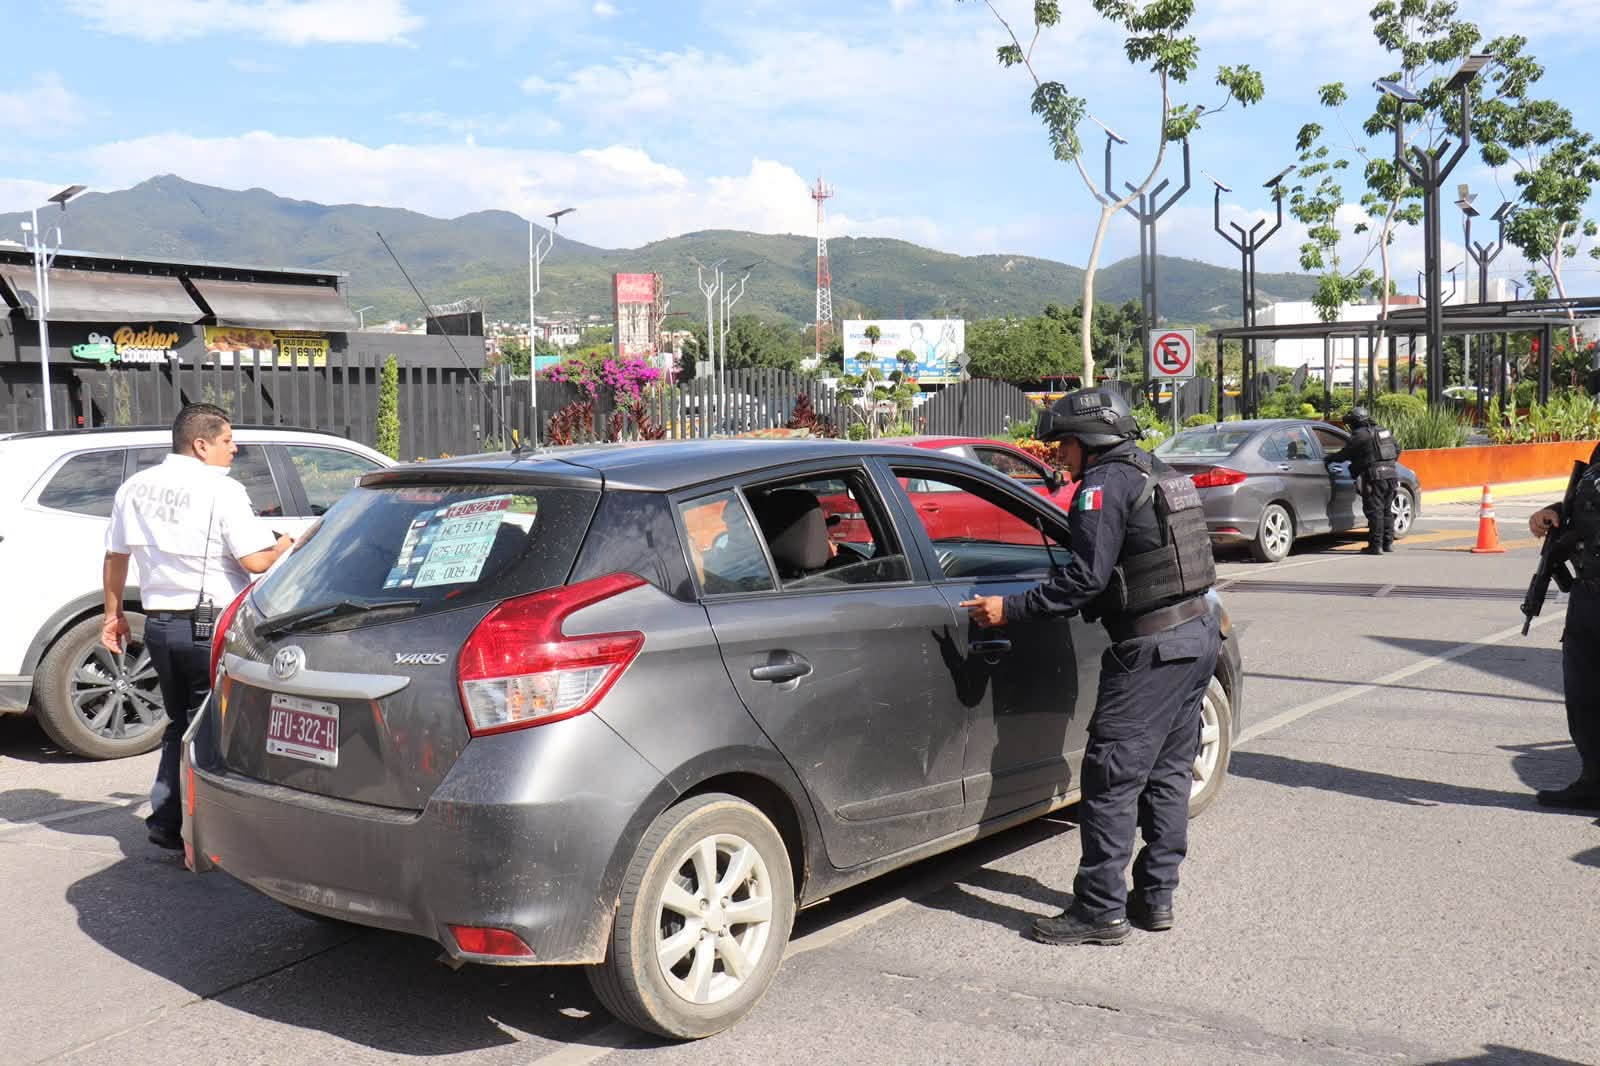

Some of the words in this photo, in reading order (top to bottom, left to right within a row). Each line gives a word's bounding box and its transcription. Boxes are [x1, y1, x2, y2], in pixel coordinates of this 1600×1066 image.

[1163, 341, 1180, 365] E
[393, 652, 449, 665] YARIS
[269, 709, 336, 749] HFU-322-H
